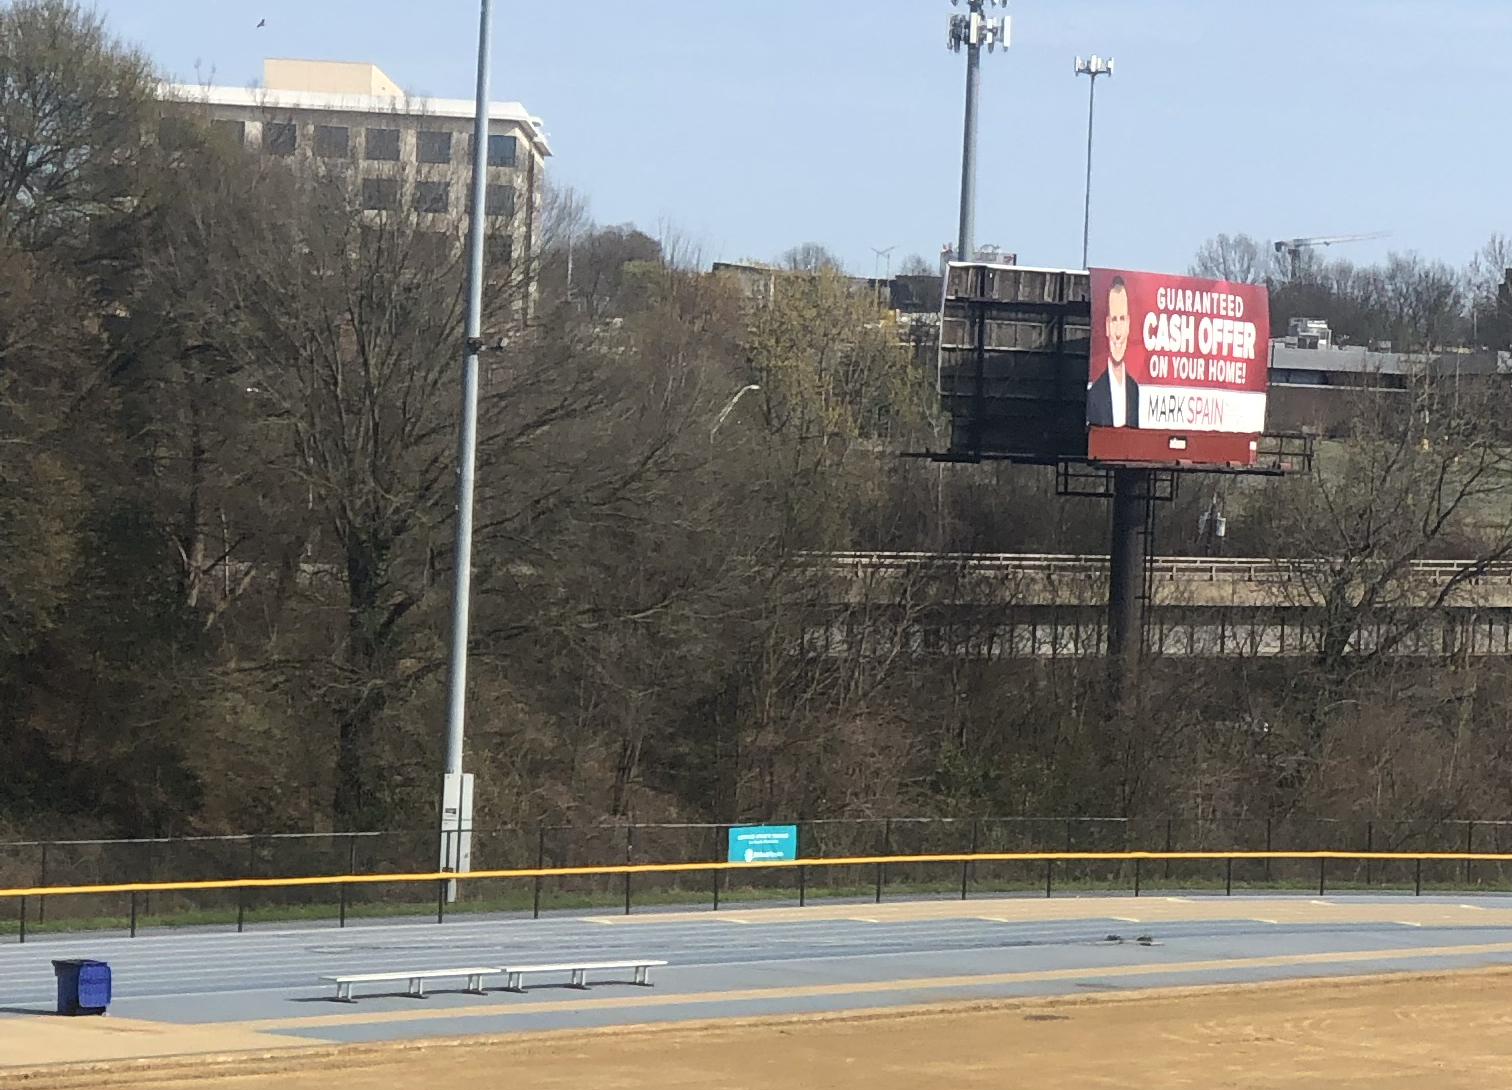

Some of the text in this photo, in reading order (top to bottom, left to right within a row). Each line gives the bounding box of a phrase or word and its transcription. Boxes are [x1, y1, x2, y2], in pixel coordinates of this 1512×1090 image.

[1157, 287, 1244, 318] GUARANTEED
[1143, 312, 1256, 359] CASH OFFER
[1150, 355, 1246, 384] ON YOUR HOME!
[1148, 395, 1186, 422] MARK
[1187, 397, 1224, 425] SPAIN
